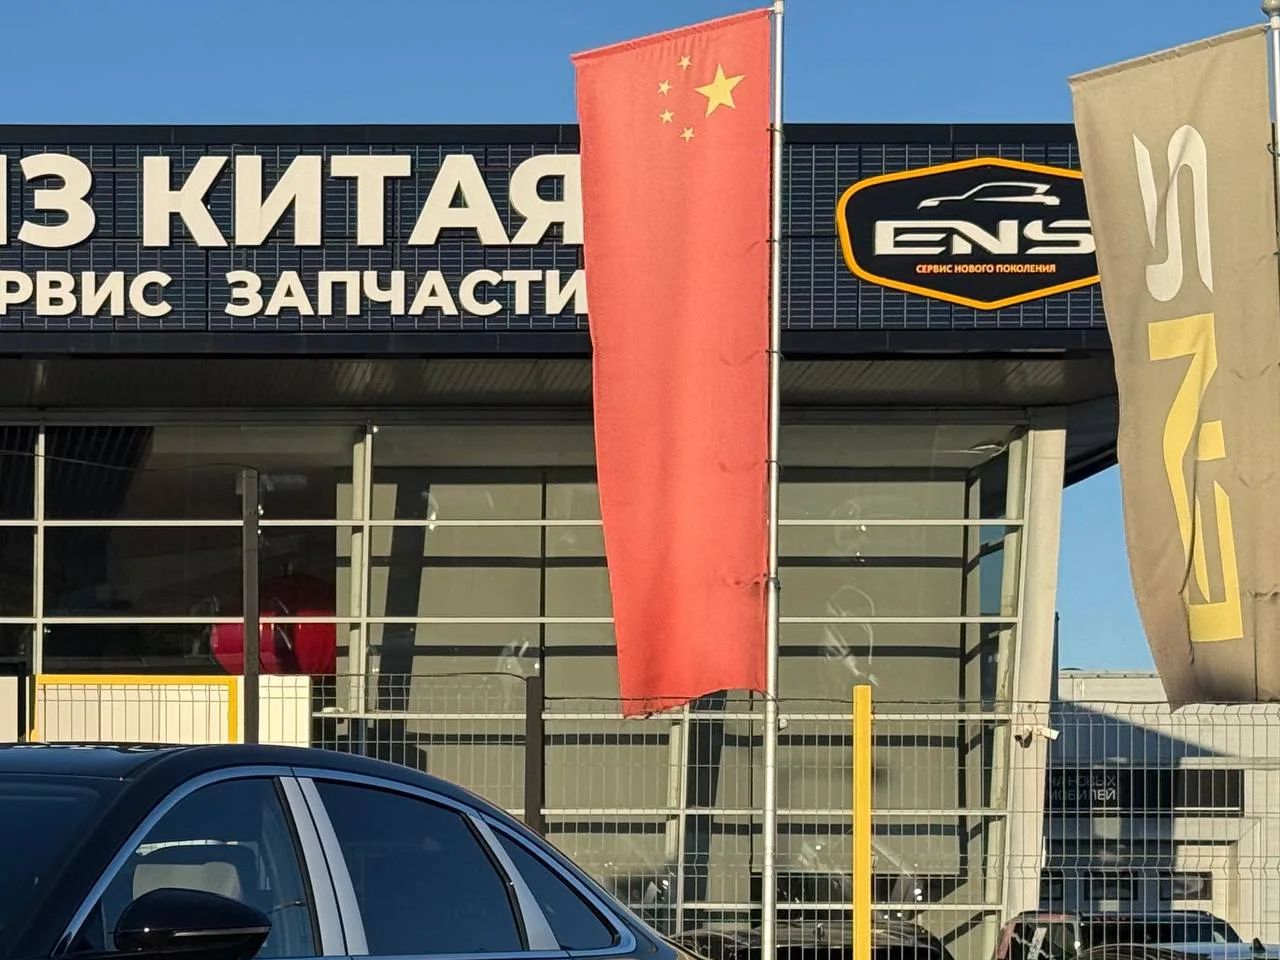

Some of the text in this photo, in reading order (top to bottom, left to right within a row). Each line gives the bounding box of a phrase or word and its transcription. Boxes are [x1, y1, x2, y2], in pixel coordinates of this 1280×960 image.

[141, 152, 585, 248] КИТАЯ
[873, 219, 1097, 256] ENS
[915, 263, 1056, 274] СЕРВИС НОВОГО ПОКОЛЕНИЯ
[223, 268, 589, 318] ЗАПЧАСТИ
